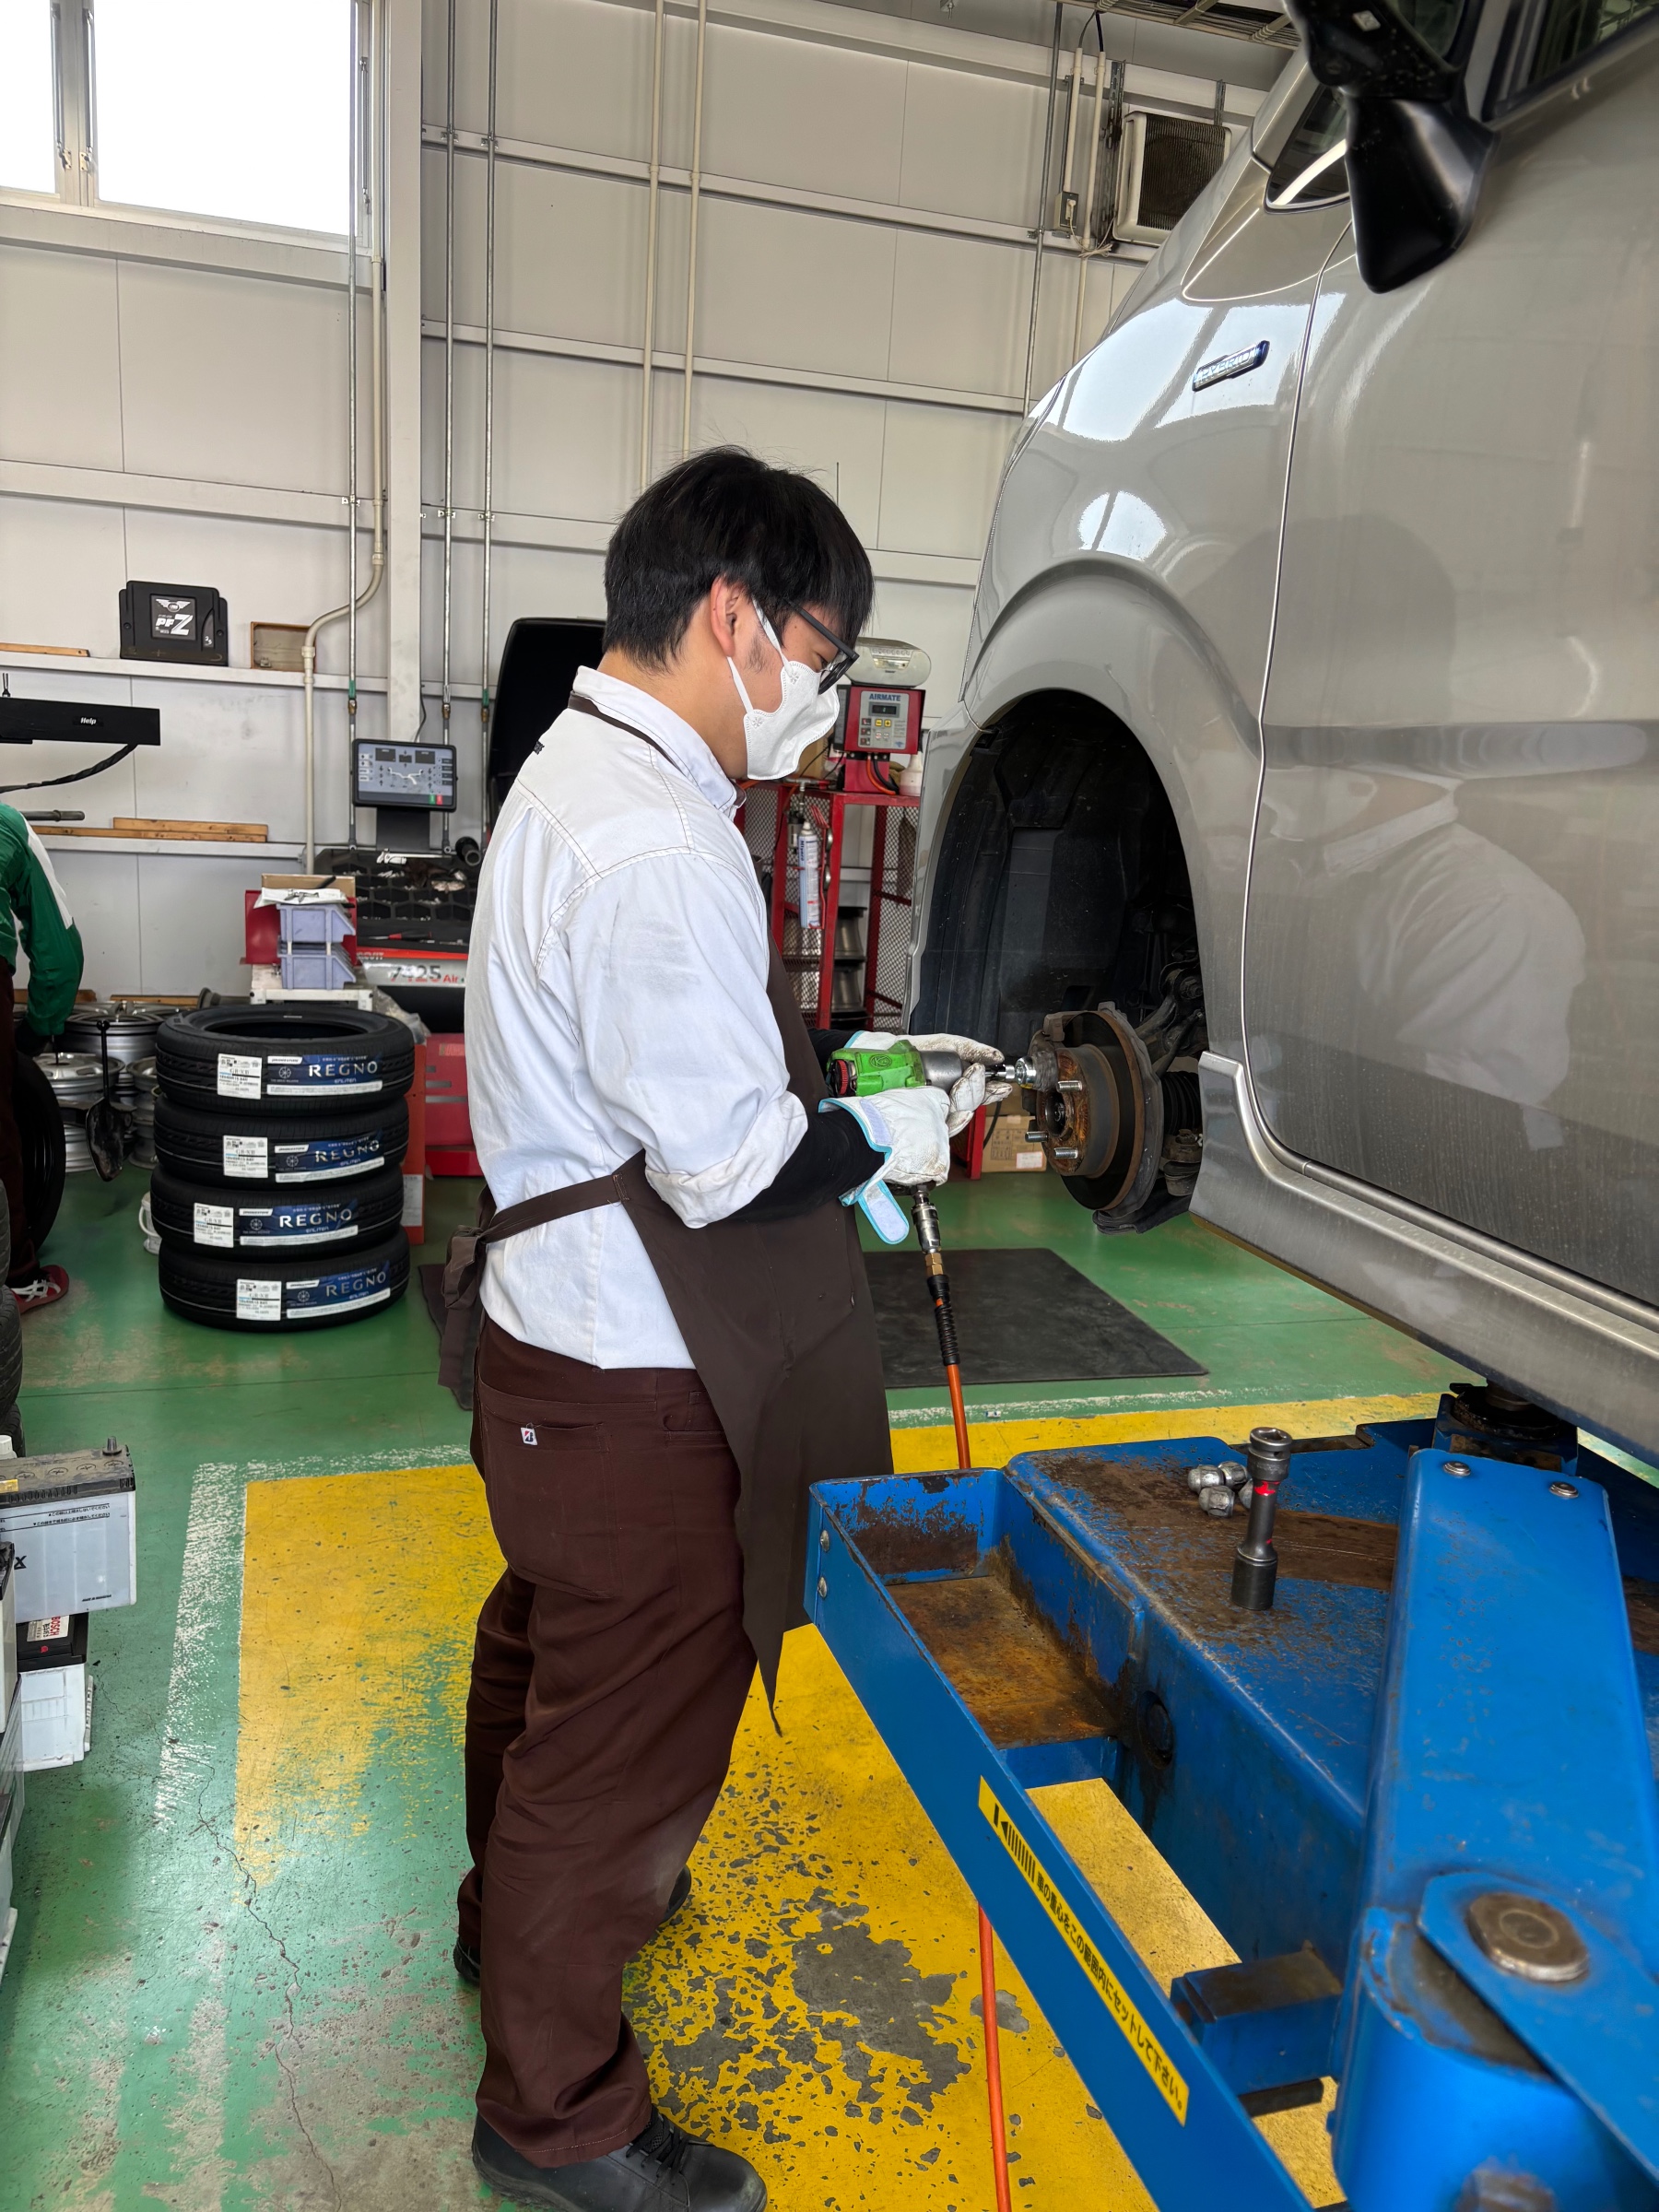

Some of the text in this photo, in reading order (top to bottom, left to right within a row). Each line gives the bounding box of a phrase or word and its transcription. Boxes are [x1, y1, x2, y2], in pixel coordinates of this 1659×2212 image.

[869, 693, 901, 701] AIRMATE
[80, 717, 97, 725] Help
[309, 1061, 378, 1077] REGNO
[315, 1140, 380, 1162] REGNO
[279, 1208, 352, 1228] REGNO
[326, 1272, 386, 1297] REGNO
[50, 1616, 61, 1637] BOSCH
[1037, 1871, 1182, 2111] 車の重心をこの範囲内にセットして下さい。
